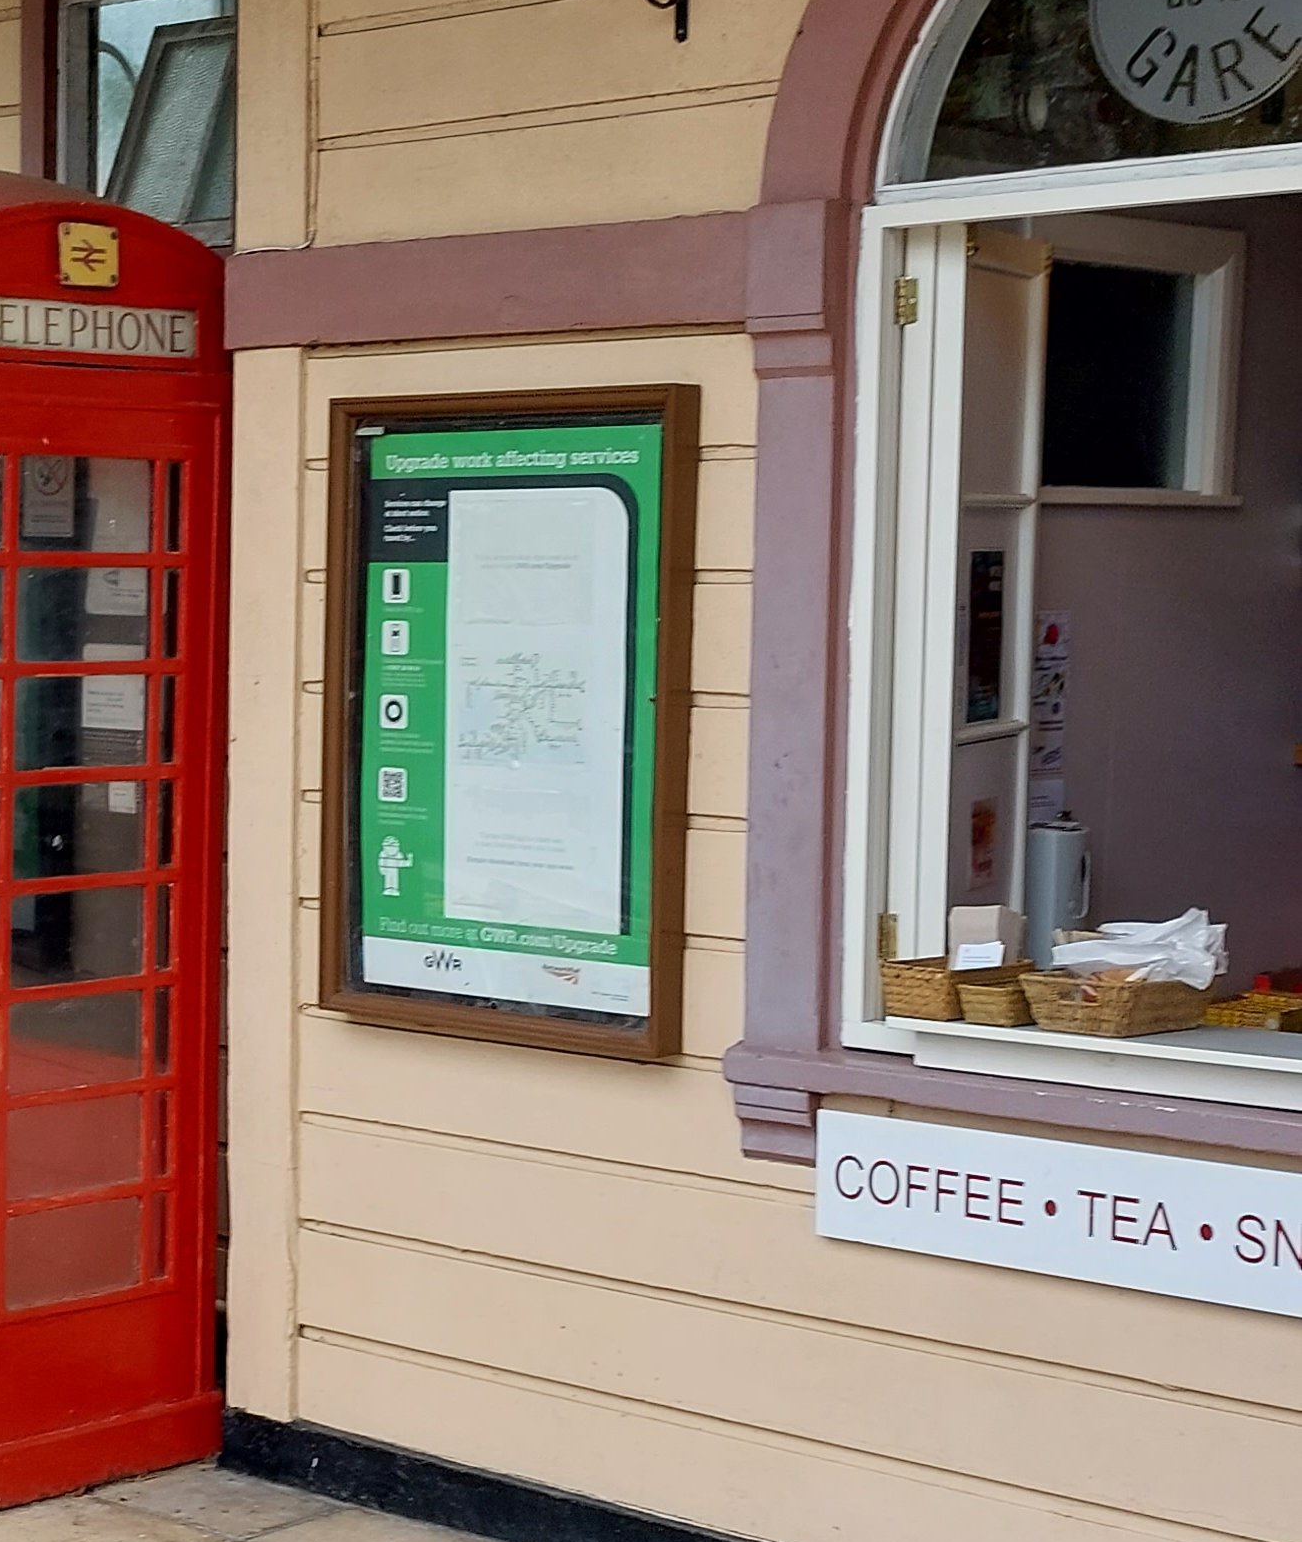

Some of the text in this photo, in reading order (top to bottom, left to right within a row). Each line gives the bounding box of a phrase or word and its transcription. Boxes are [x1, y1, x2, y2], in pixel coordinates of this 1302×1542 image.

[1124, 6, 1302, 107] GARE
[385, 447, 640, 474] Upgrade work affecting services
[379, 917, 407, 934] Find
[408, 924, 428, 935] out
[430, 925, 463, 940] more
[464, 928, 478, 942] at
[835, 1154, 1026, 1227] COFFEE
[1077, 1189, 1178, 1251] TEA
